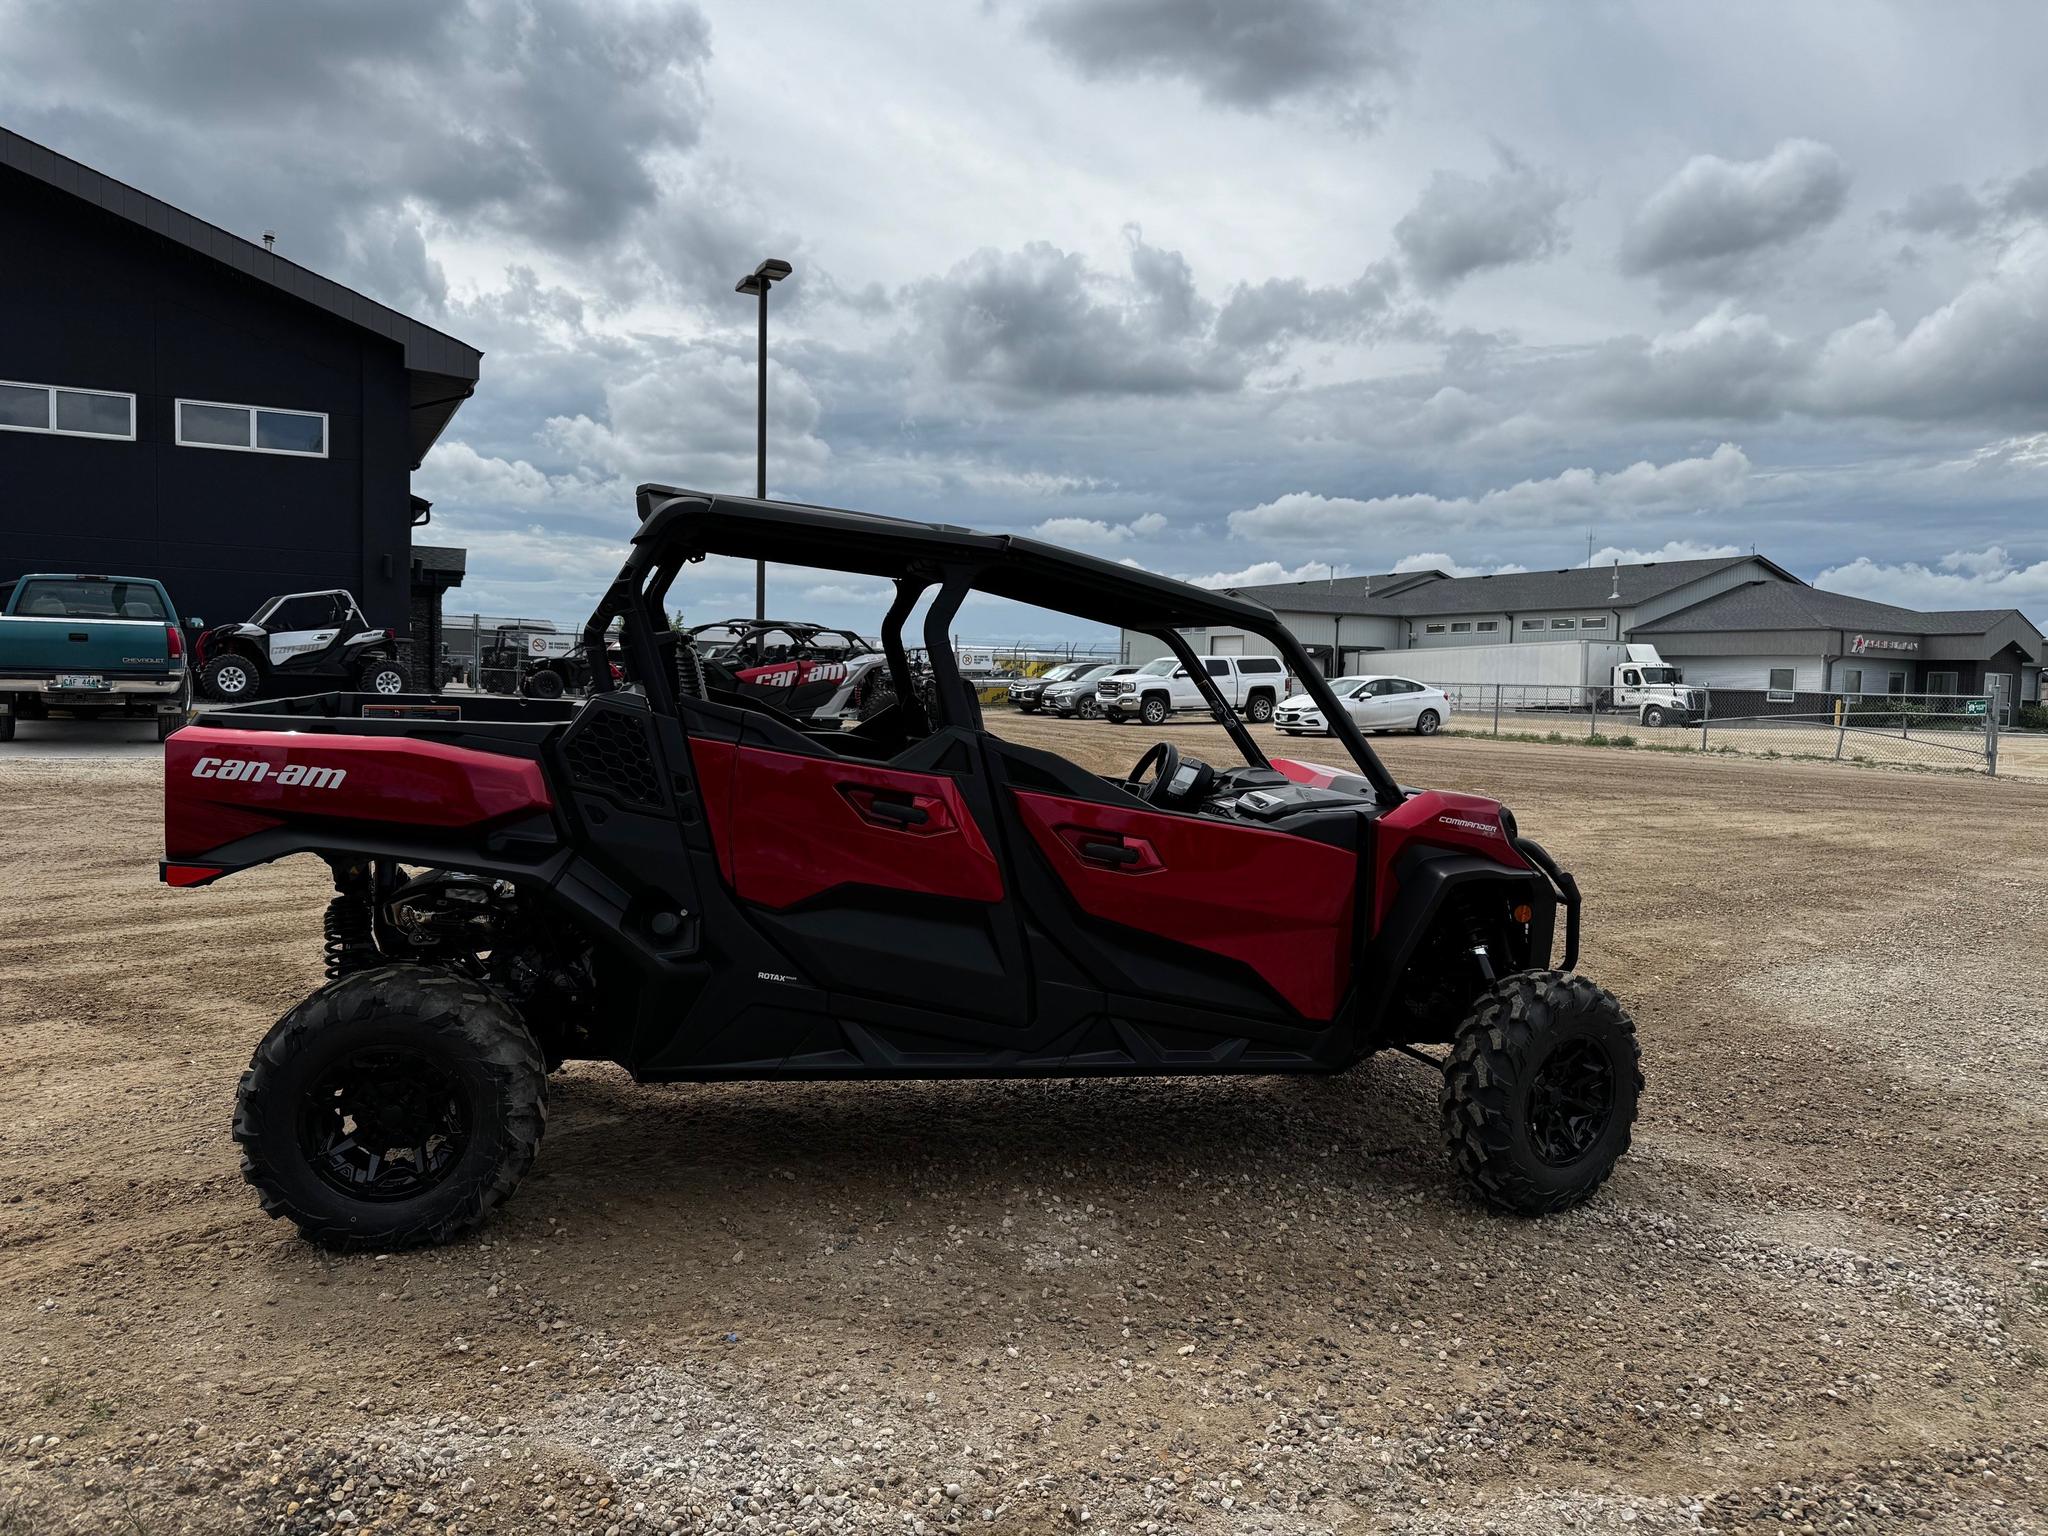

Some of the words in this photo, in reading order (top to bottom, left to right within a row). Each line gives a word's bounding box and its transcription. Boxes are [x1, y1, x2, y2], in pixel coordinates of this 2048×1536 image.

[271, 643, 321, 655] can-am
[82, 679, 96, 688] 444
[192, 757, 347, 789] can-am
[1439, 816, 1498, 833] COMMANDER
[758, 971, 786, 982] ROTAX
